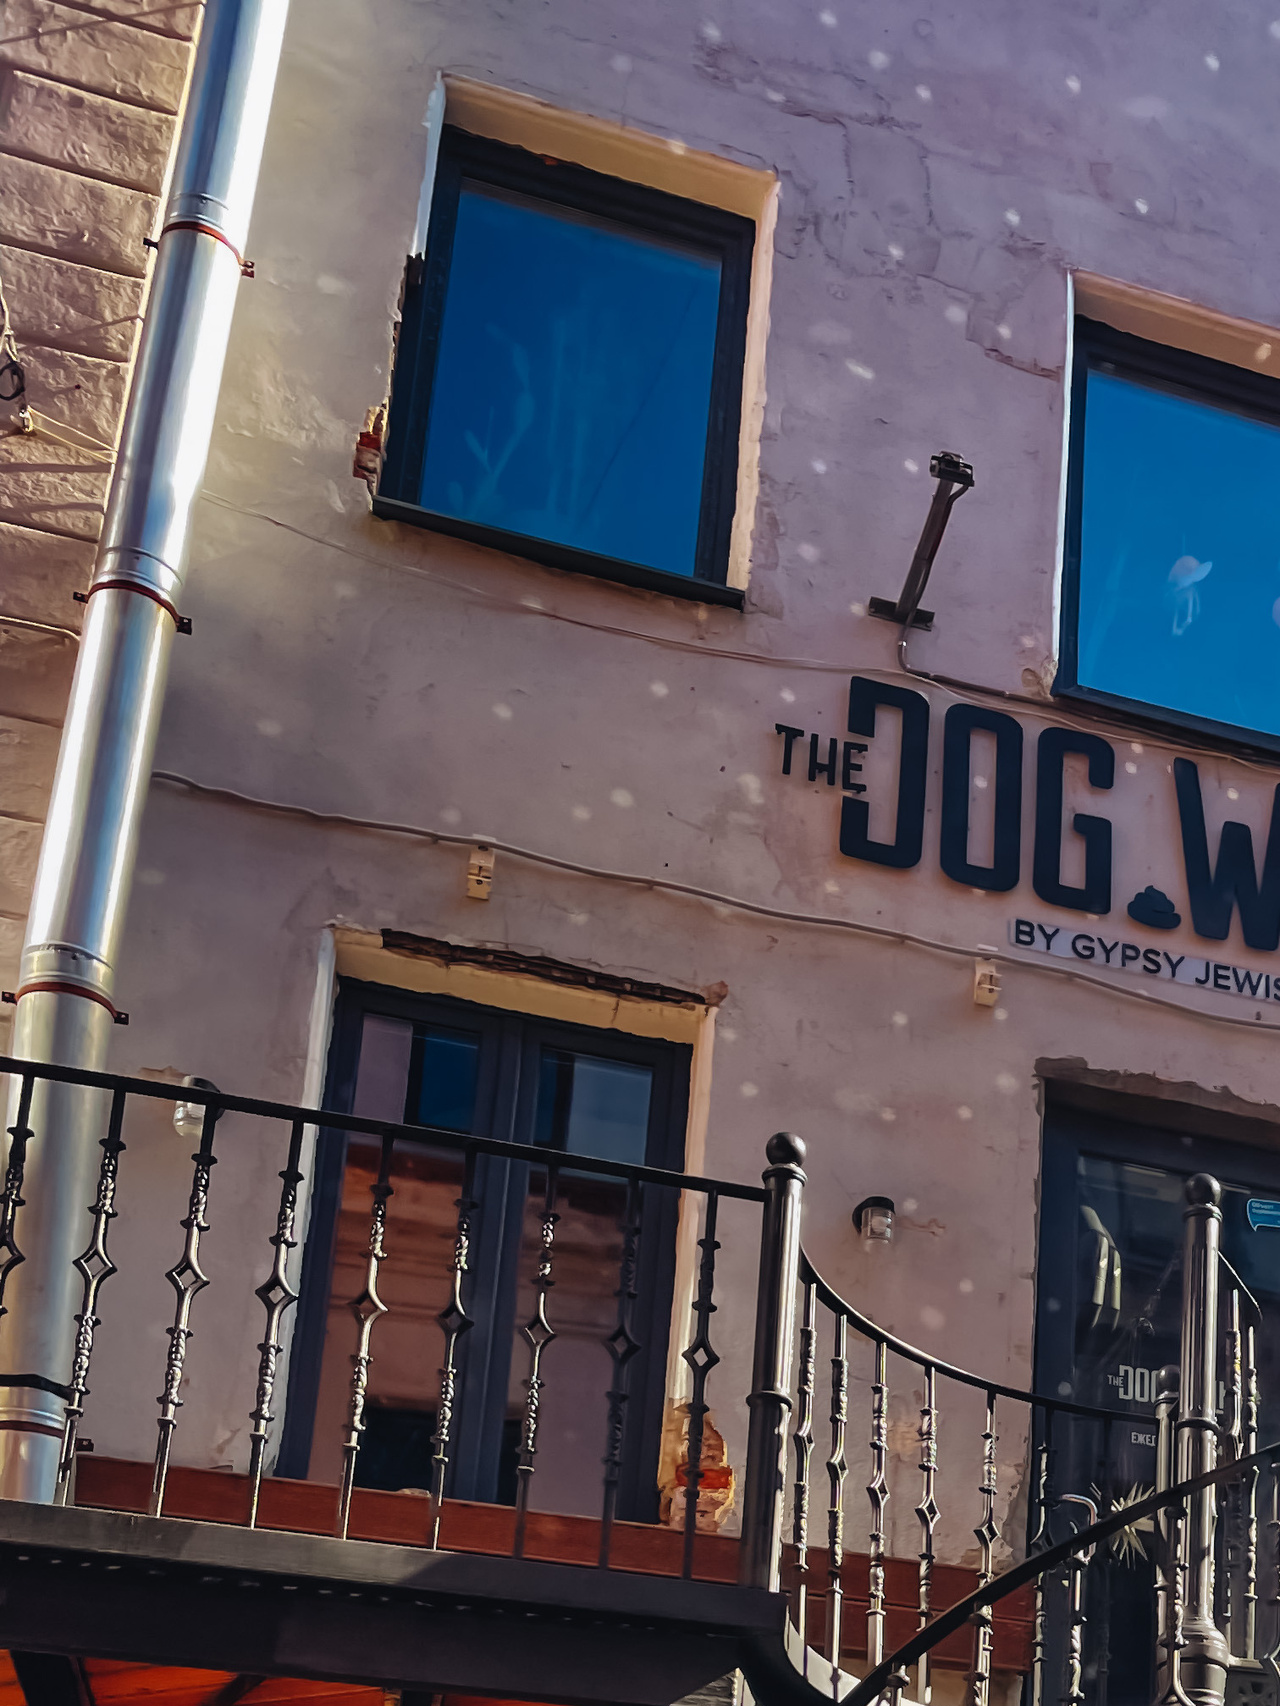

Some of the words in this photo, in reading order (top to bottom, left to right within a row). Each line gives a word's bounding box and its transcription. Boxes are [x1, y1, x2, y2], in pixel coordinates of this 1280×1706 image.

[775, 722, 869, 795] THE
[838, 674, 1117, 916] DOG
[1013, 918, 1061, 952] BY
[1070, 931, 1186, 980] GYPSY
[1107, 1374, 1125, 1387] THE
